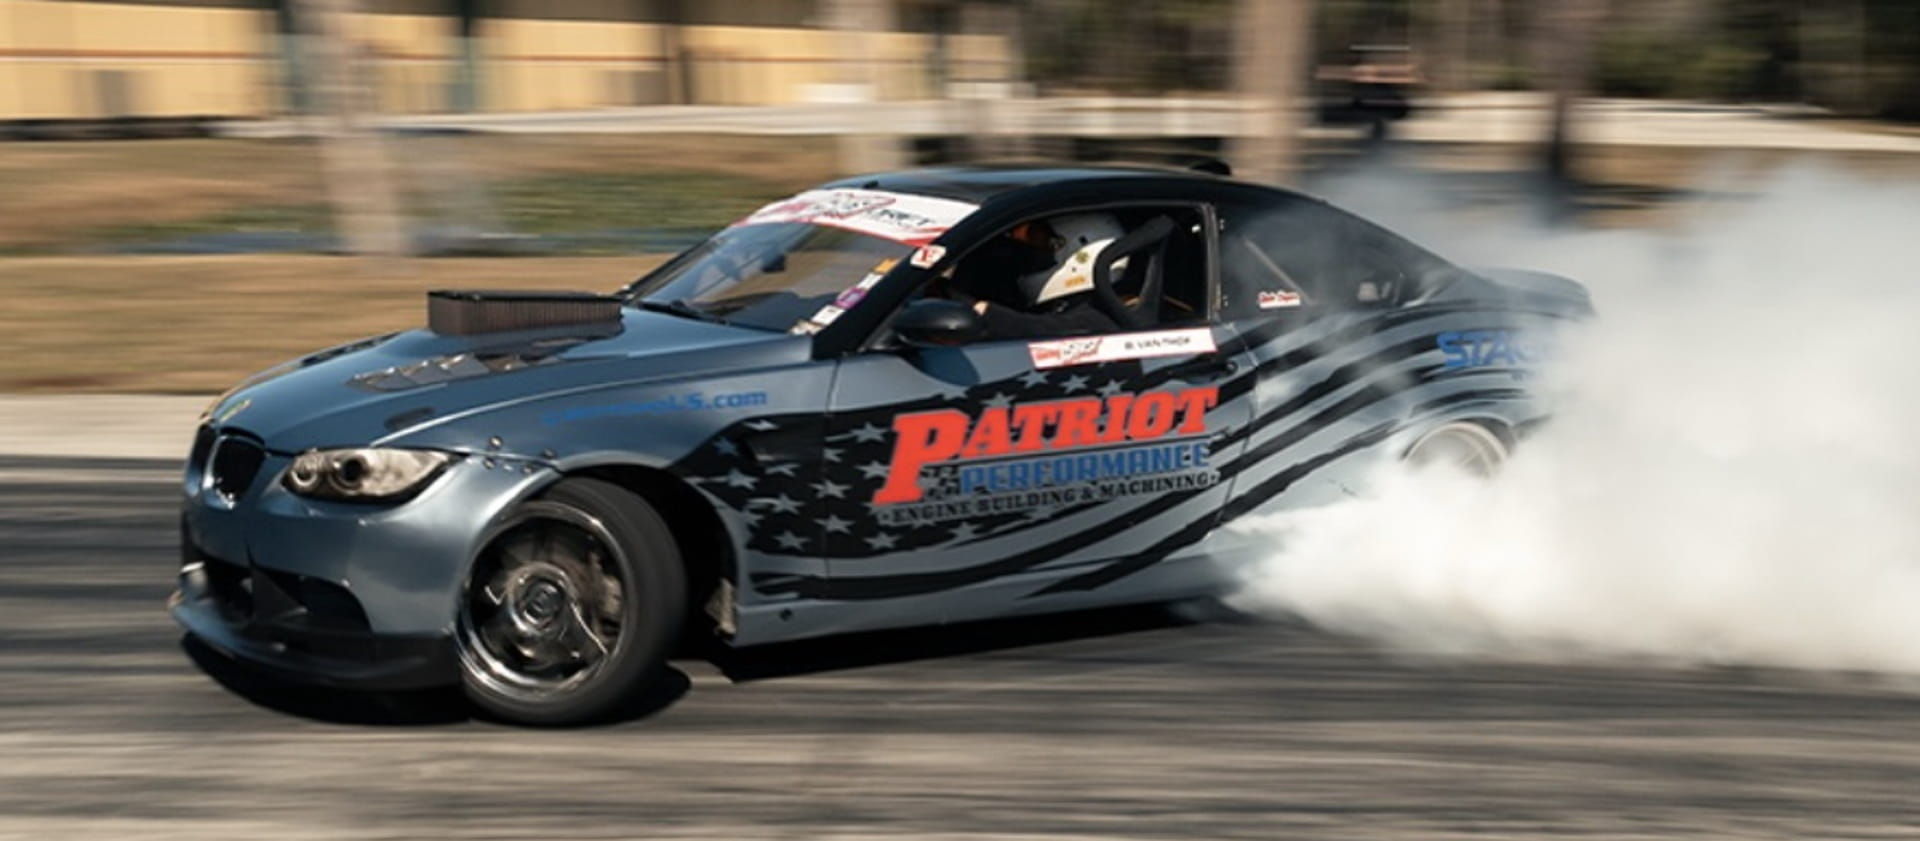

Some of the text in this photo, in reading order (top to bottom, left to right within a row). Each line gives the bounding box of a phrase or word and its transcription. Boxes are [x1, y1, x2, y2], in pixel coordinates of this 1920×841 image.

[872, 386, 1218, 505] PATRIOT
[962, 441, 1210, 494] PERFORMANCE
[893, 473, 1208, 522] ENGINE BUILDING & MACHINING
